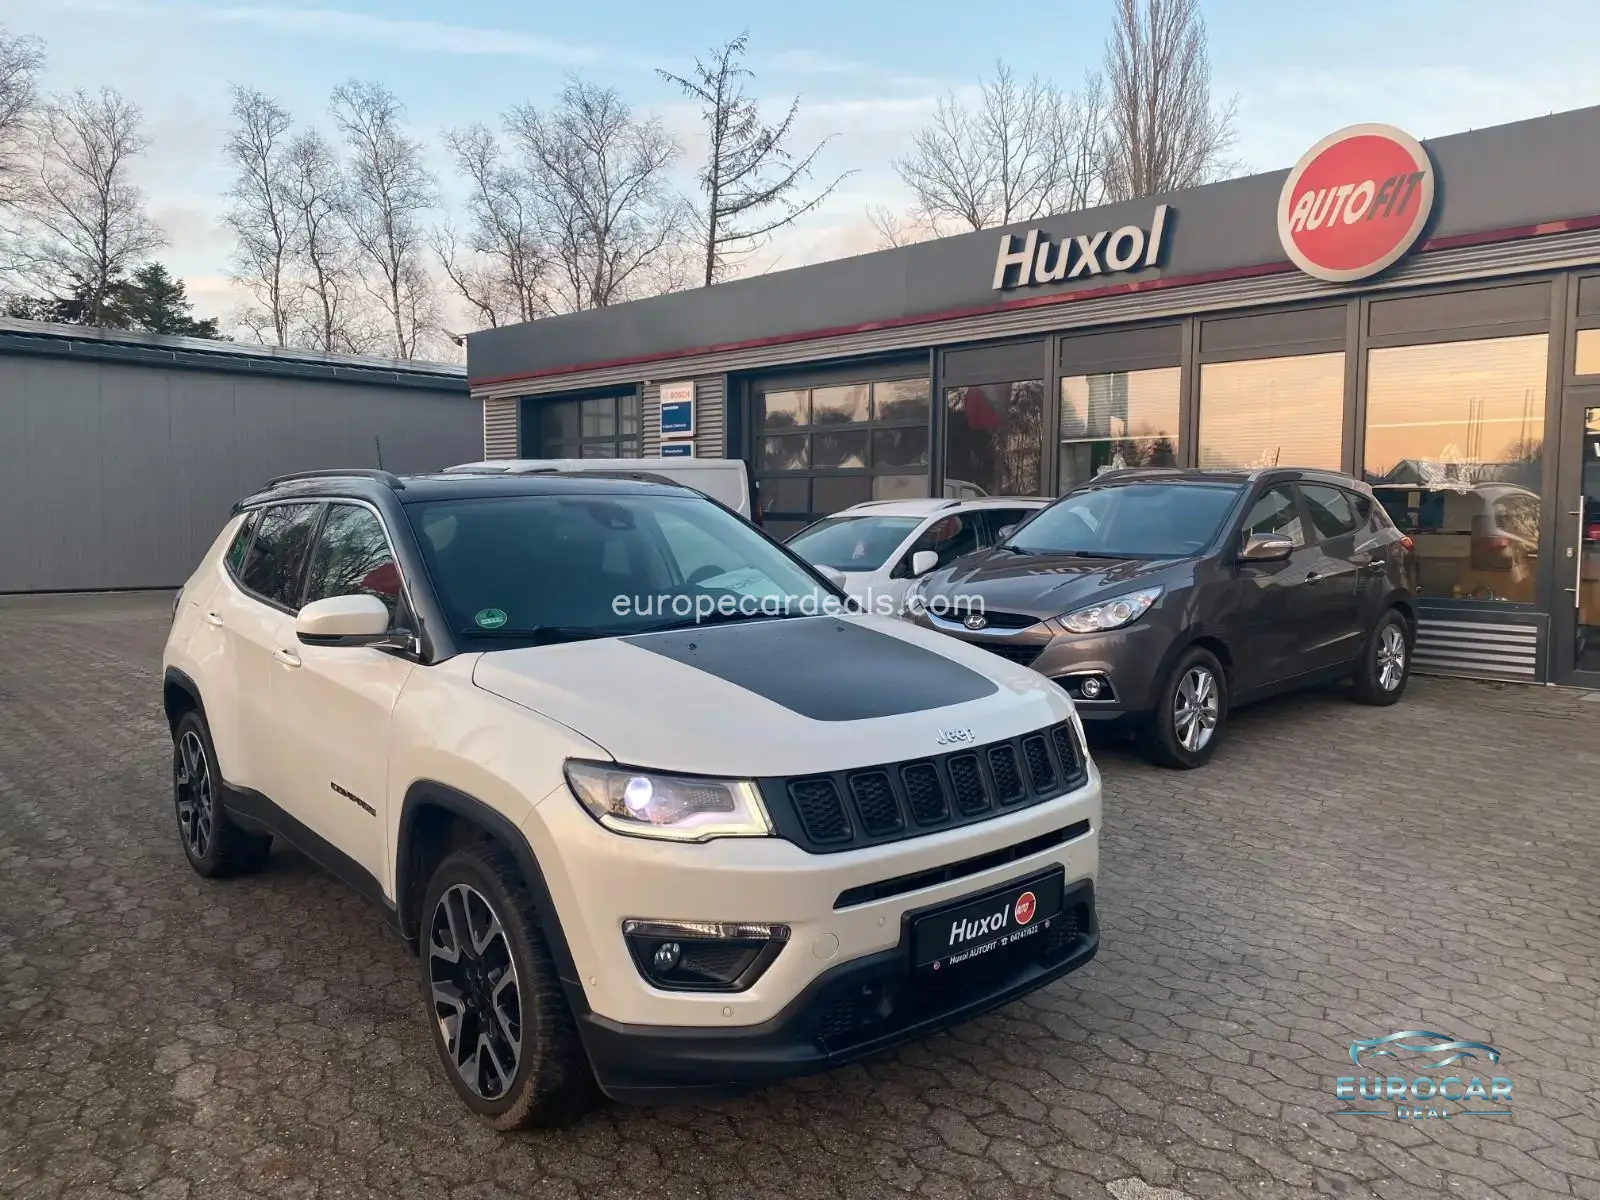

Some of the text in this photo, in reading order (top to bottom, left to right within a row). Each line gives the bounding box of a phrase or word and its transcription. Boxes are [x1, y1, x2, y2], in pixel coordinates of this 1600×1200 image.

[1289, 171, 1426, 232] AUTOFIT
[992, 203, 1168, 290] Huxol
[936, 728, 975, 745] Jeep
[949, 903, 1010, 946] Huxol
[950, 952, 968, 965] Huxol
[969, 941, 997, 958] AUTOFIT
